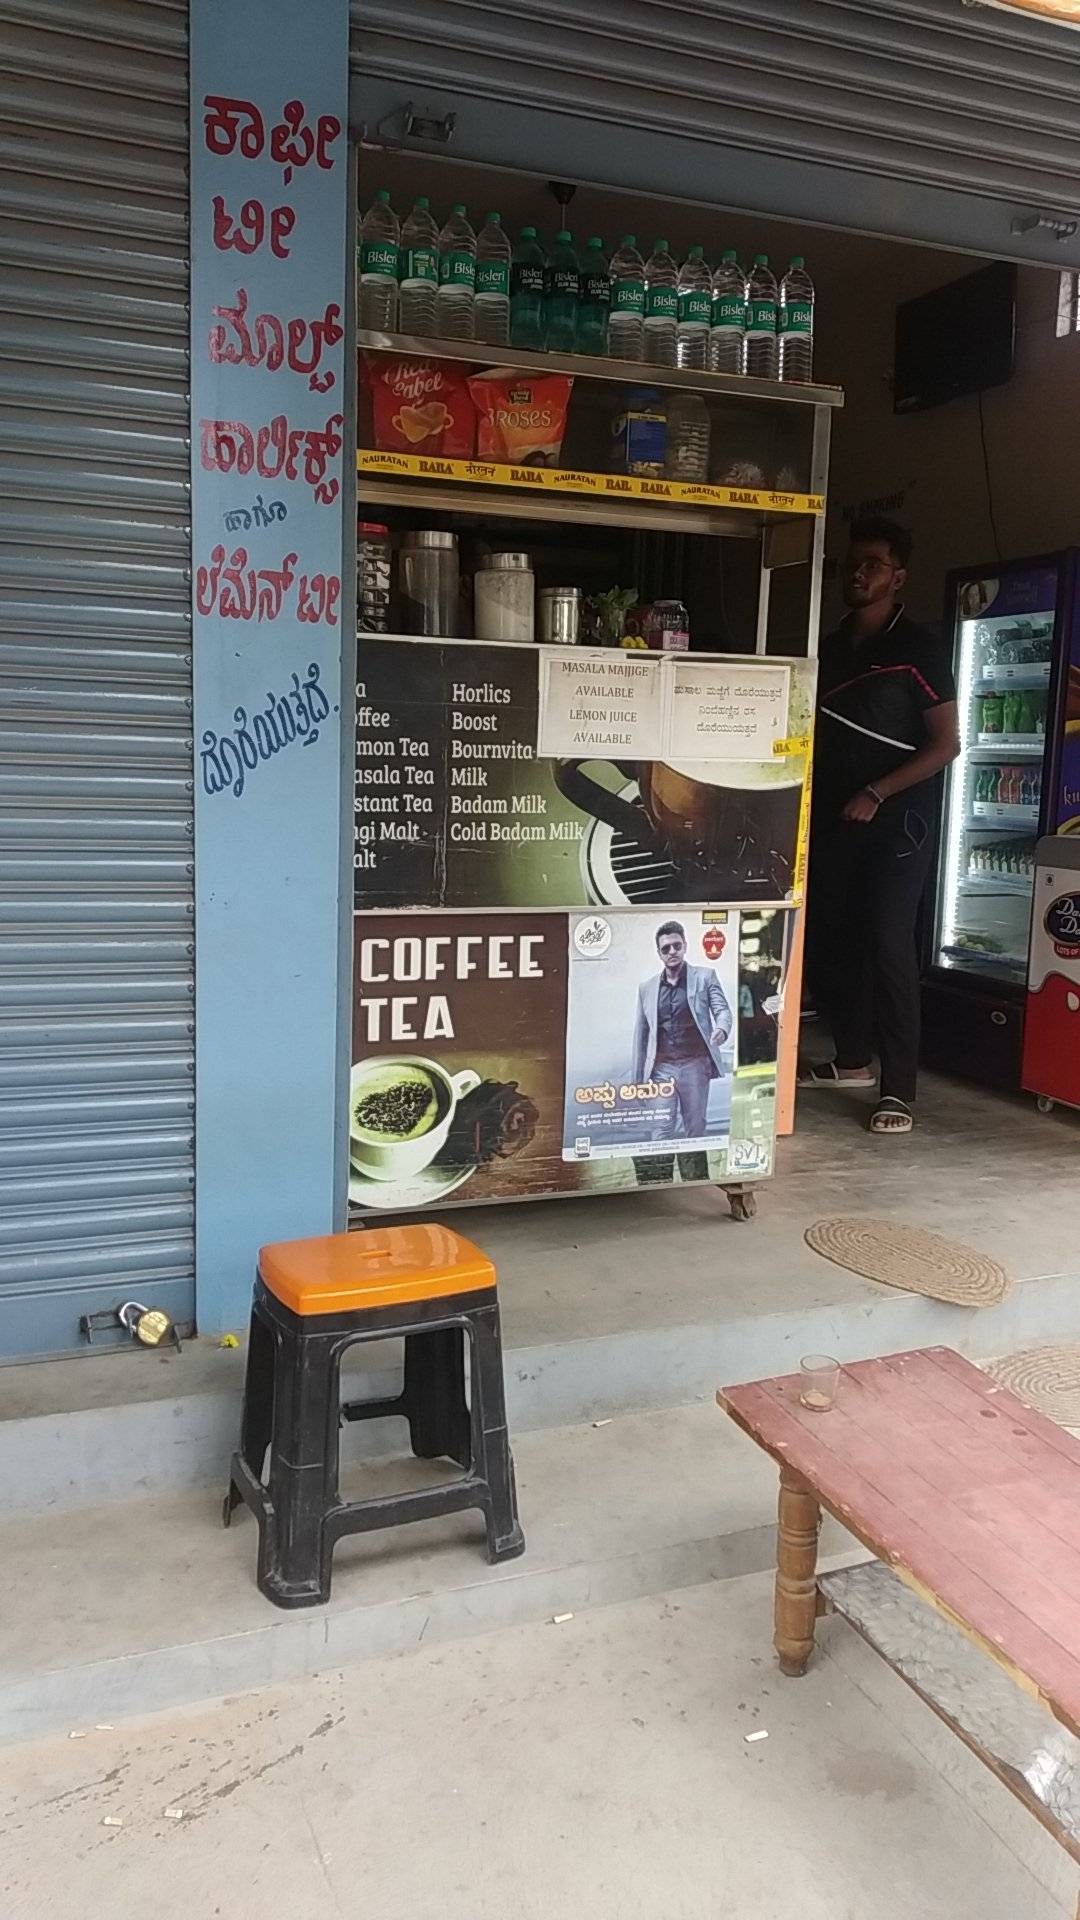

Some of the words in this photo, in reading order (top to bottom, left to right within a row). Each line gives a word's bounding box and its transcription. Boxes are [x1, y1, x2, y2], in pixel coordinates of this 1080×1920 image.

[212, 195, 297, 259] ಟೀ
[418, 460, 454, 475] BABA
[509, 468, 545, 483] BABA
[640, 481, 672, 496] BABA
[728, 491, 760, 505] BABA
[297, 573, 341, 626] ಟೀ
[561, 661, 606, 675] MASALA
[452, 683, 511, 704] Horlics
[575, 685, 634, 699] AVAILABLE
[355, 706, 391, 727] ffee
[452, 711, 498, 732] Boost
[569, 709, 607, 721] LEMON
[609, 711, 638, 724] JUICE
[399, 737, 430, 757] Tea
[573, 732, 632, 745] AVAILABLE
[451, 740, 533, 759] Bournvita
[404, 766, 435, 785] Tea
[450, 767, 488, 786] Milk
[402, 794, 433, 813] Tea
[450, 795, 508, 814] Badam
[511, 795, 547, 814] Milk
[379, 821, 421, 841] Malt
[450, 822, 487, 841] Cold
[490, 822, 546, 841] Badam
[549, 822, 584, 841] Milk
[360, 935, 545, 983] COFFEE
[360, 995, 455, 1042] TEA
[619, 1076, 676, 1101] ಅಮರ
